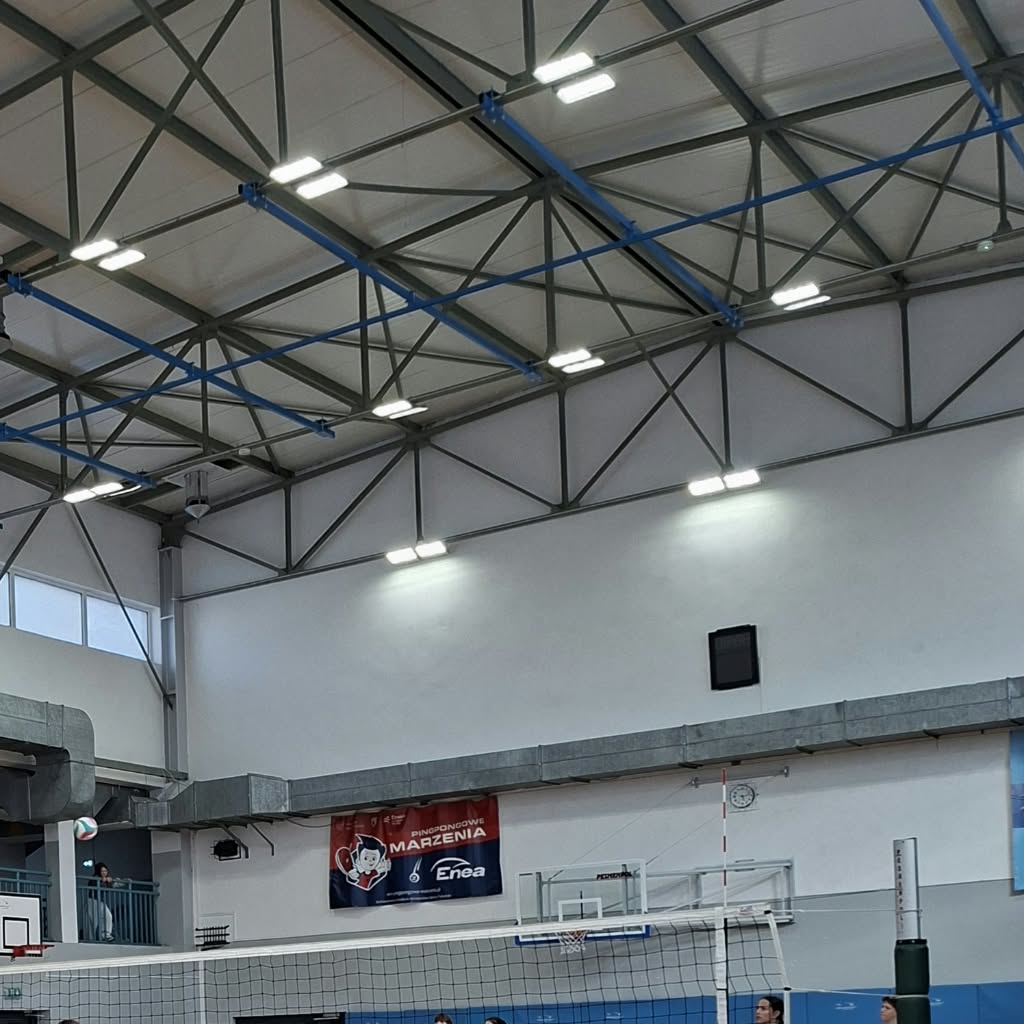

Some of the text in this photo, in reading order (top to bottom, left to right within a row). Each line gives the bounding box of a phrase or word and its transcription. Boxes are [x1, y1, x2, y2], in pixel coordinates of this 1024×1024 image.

[410, 817, 485, 838] PINGPONGOWE
[389, 827, 487, 854] MARZENIA
[436, 866, 486, 881] Enea
